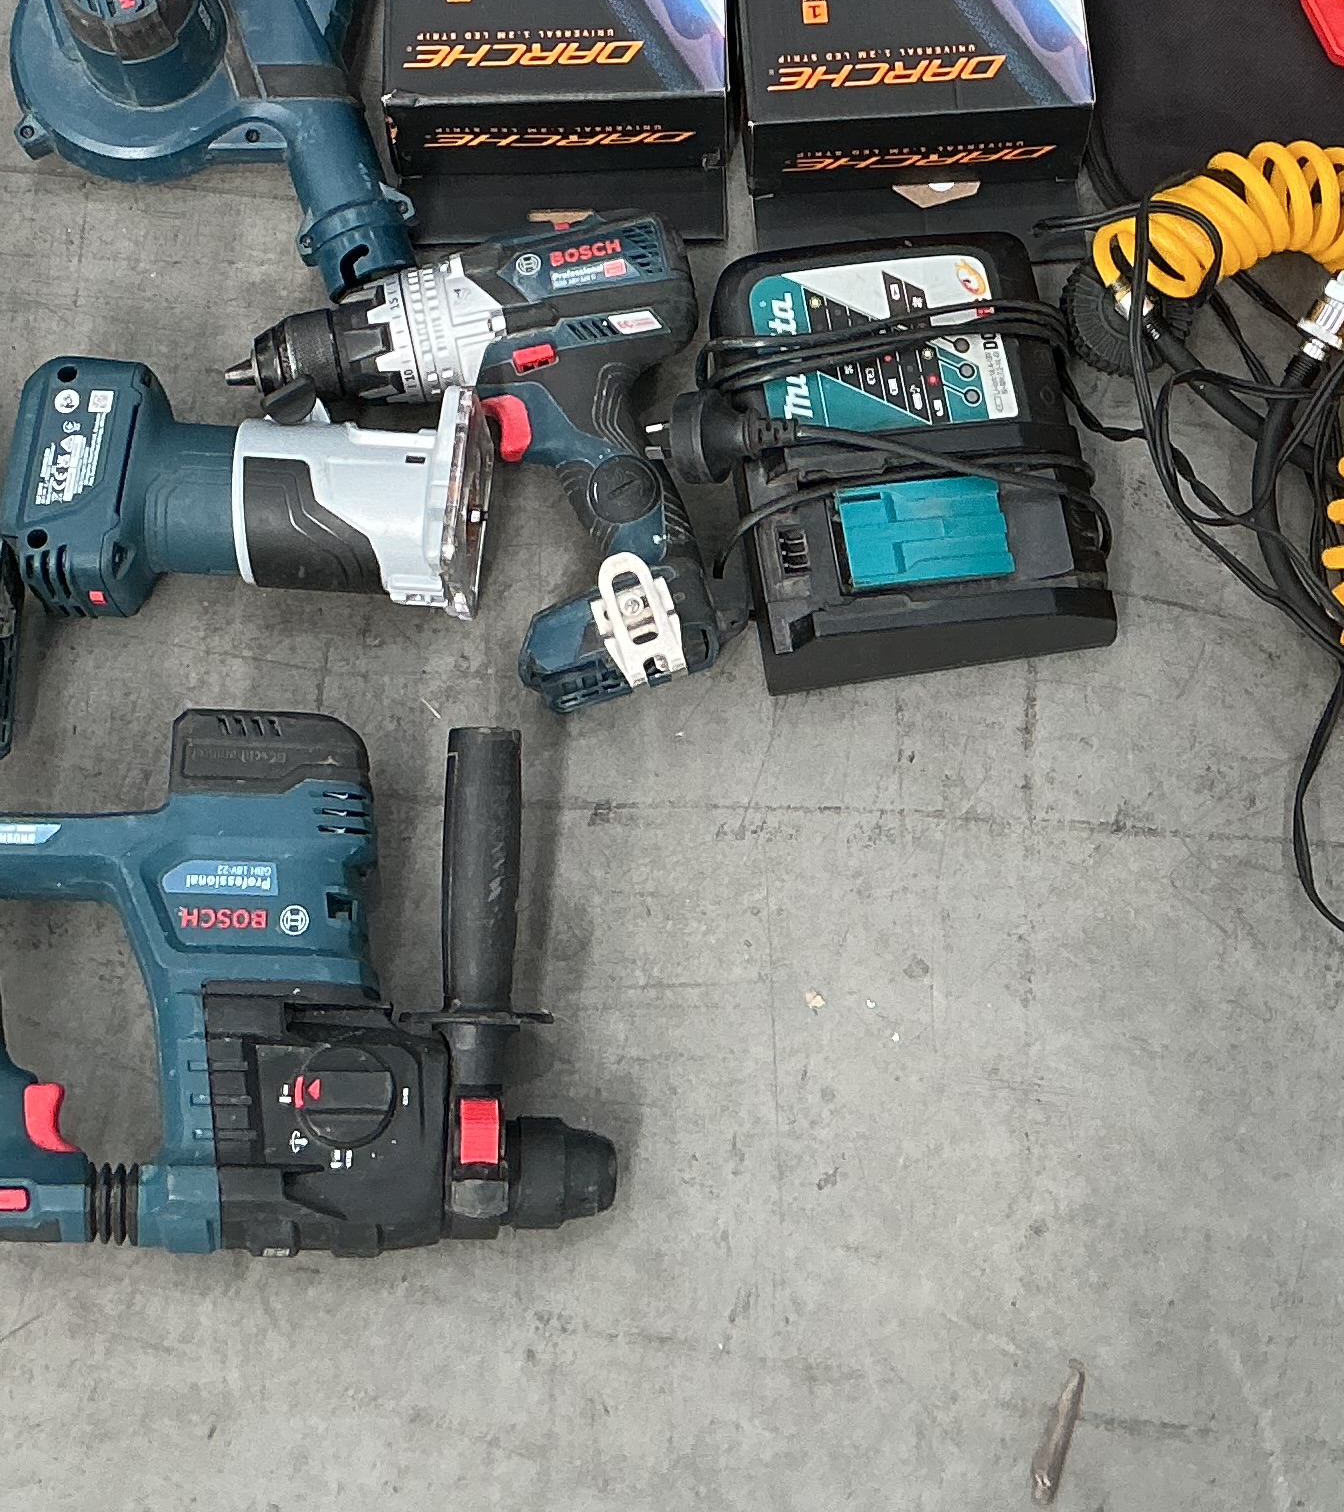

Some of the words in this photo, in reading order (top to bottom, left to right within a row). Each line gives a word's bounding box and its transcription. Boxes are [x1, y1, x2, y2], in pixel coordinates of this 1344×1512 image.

[417, 32, 457, 41] STRIP
[465, 31, 489, 40] LED
[497, 31, 531, 40] 1.2M
[539, 28, 614, 39] UNIVERSAL
[403, 39, 644, 69] DARCHE
[826, 51, 850, 62] LED
[857, 48, 891, 60] 1.2M
[899, 44, 976, 57] UNIVERSAL
[778, 53, 818, 64] STRIP
[767, 54, 1007, 92] DARCHE
[424, 131, 697, 148] DARCHE
[782, 143, 1057, 172] DARCHE
[549, 239, 622, 267] BOSCH
[403, 369, 416, 382] 10
[250, 867, 272, 876] GBH
[185, 874, 271, 891] Professional
[180, 907, 268, 929] BOSCH
